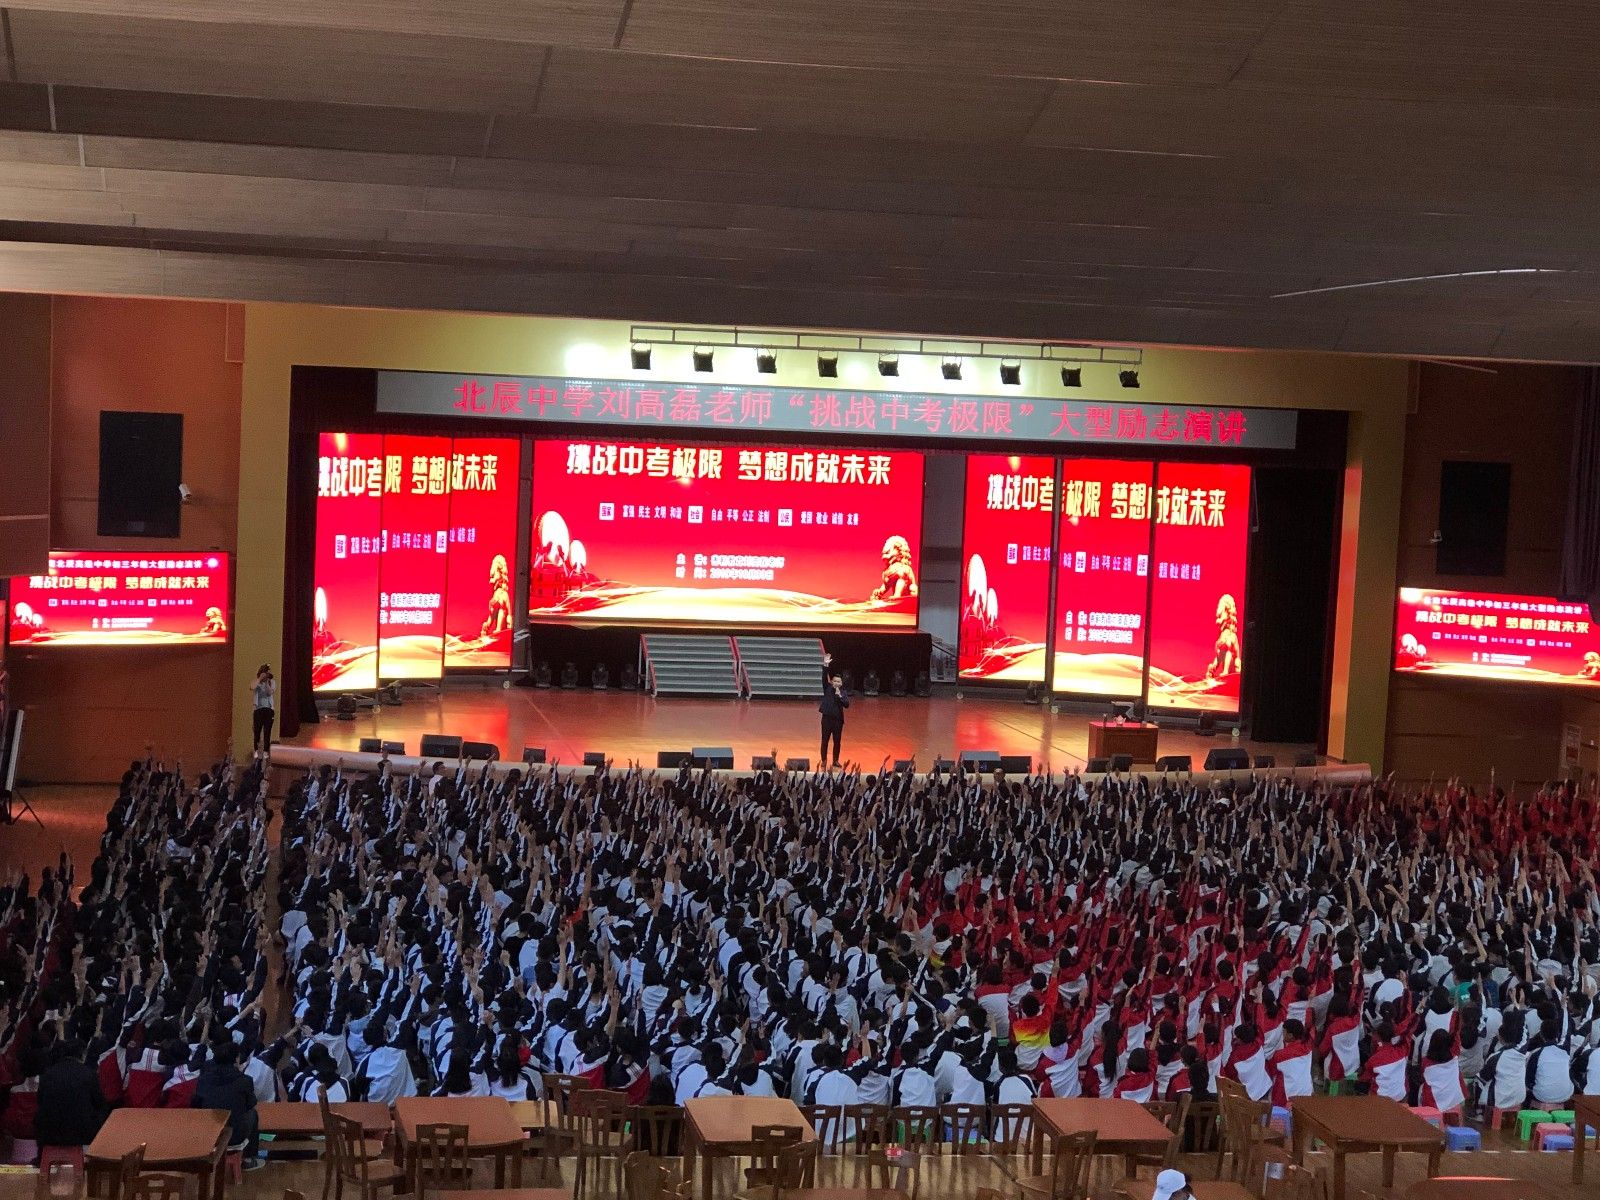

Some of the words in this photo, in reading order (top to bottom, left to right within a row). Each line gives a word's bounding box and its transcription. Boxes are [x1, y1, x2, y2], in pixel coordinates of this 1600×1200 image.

[566, 443, 722, 479] 挑战中考极限
[738, 450, 892, 485] 梦想成就未来
[637, 505, 651, 519] 民主
[653, 505, 667, 519] 文明
[669, 506, 683, 519] 和谐
[711, 508, 723, 522] 自由
[726, 508, 739, 522] 平等
[741, 510, 755, 522] 公正
[815, 512, 829, 525] 敬业
